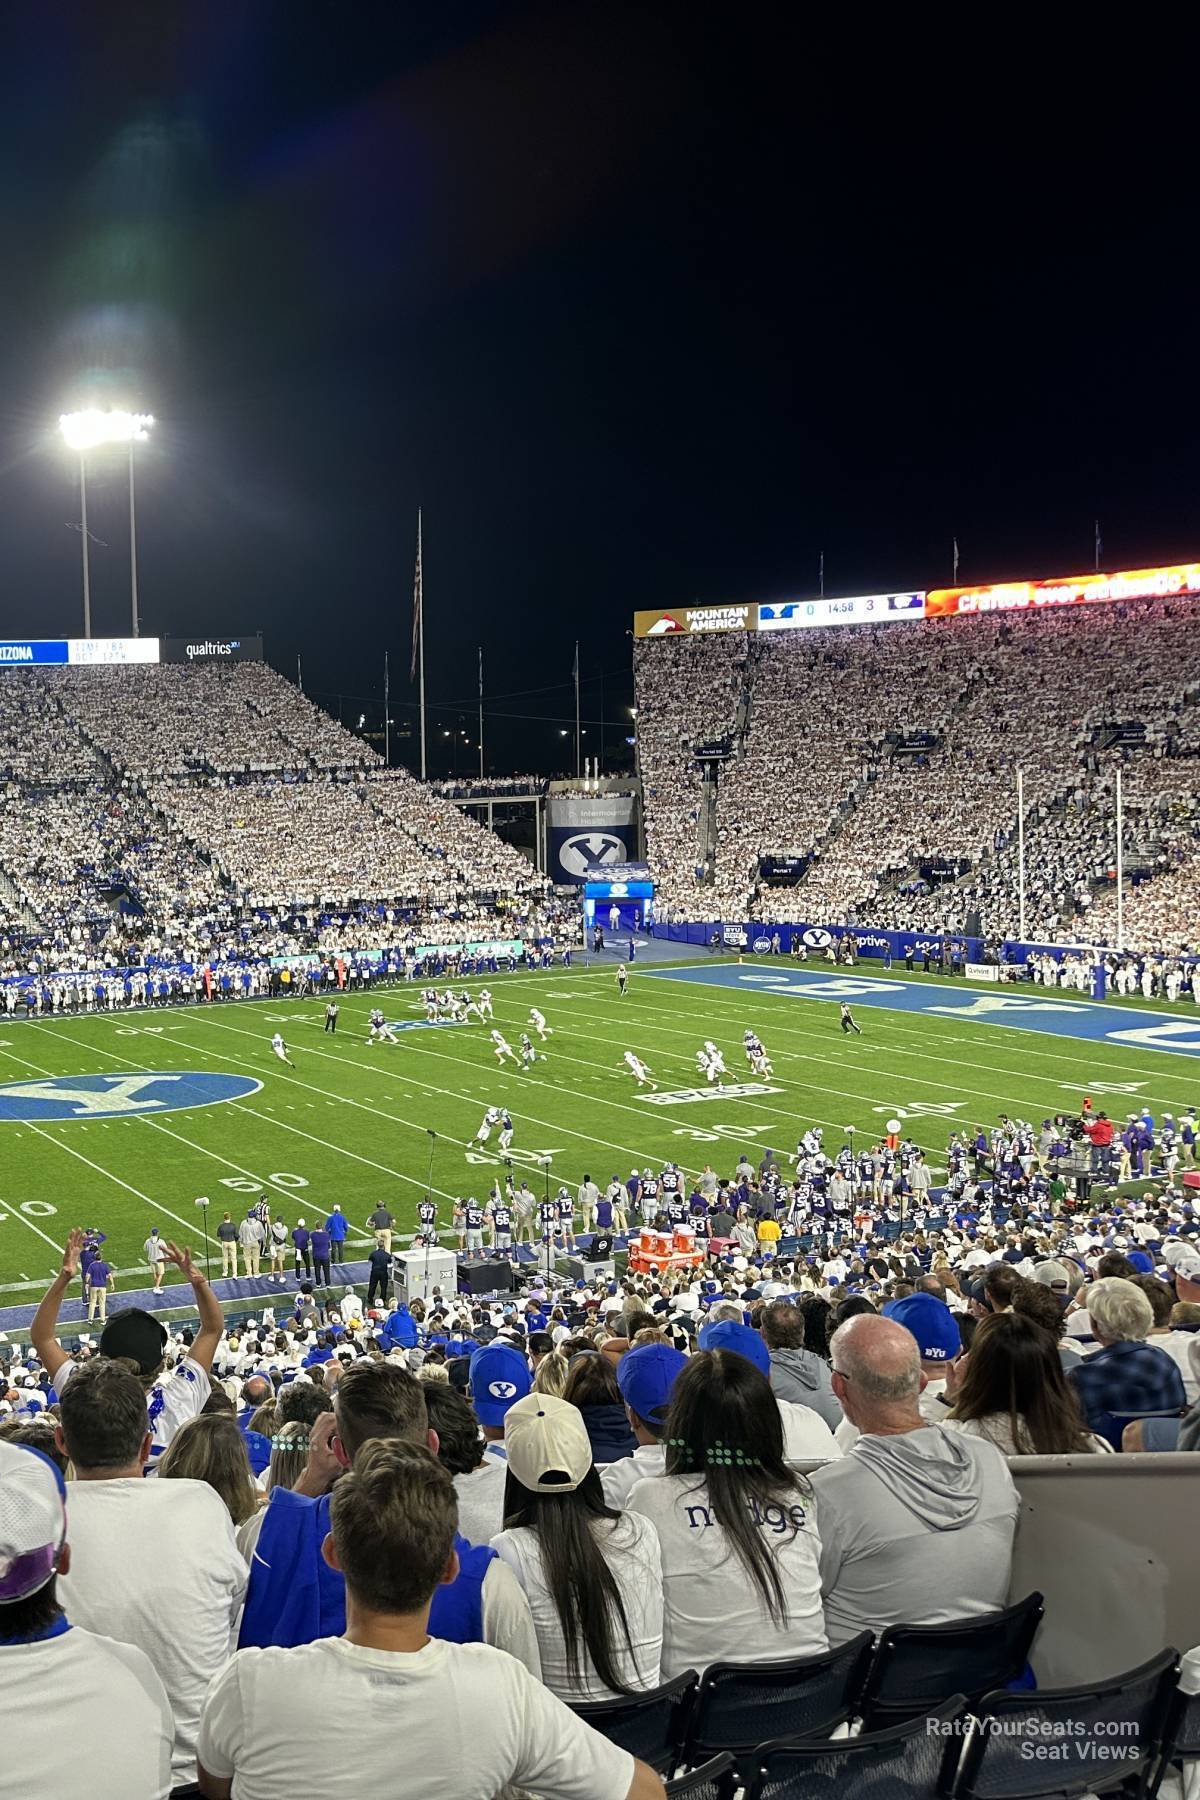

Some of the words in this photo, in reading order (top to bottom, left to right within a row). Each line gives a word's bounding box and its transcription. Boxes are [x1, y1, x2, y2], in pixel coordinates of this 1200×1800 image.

[806, 604, 814, 616] 0
[828, 602, 854, 613] 14:58
[866, 600, 874, 611] 3
[687, 606, 748, 622] MOUNTAIN
[690, 617, 745, 632] AMERICA
[857, 935, 886, 949] ptive
[671, 1124, 758, 1142] 30
[217, 1172, 310, 1193] 50
[663, 1176, 677, 1187] 56
[643, 1183, 657, 1195] 78
[561, 1201, 573, 1212] 17
[420, 1207, 435, 1219] 87
[468, 1213, 483, 1224] 53
[668, 1207, 682, 1219] 55
[495, 1214, 510, 1225] 66
[690, 1219, 705, 1231] 93
[924, 1346, 946, 1359] BYU
